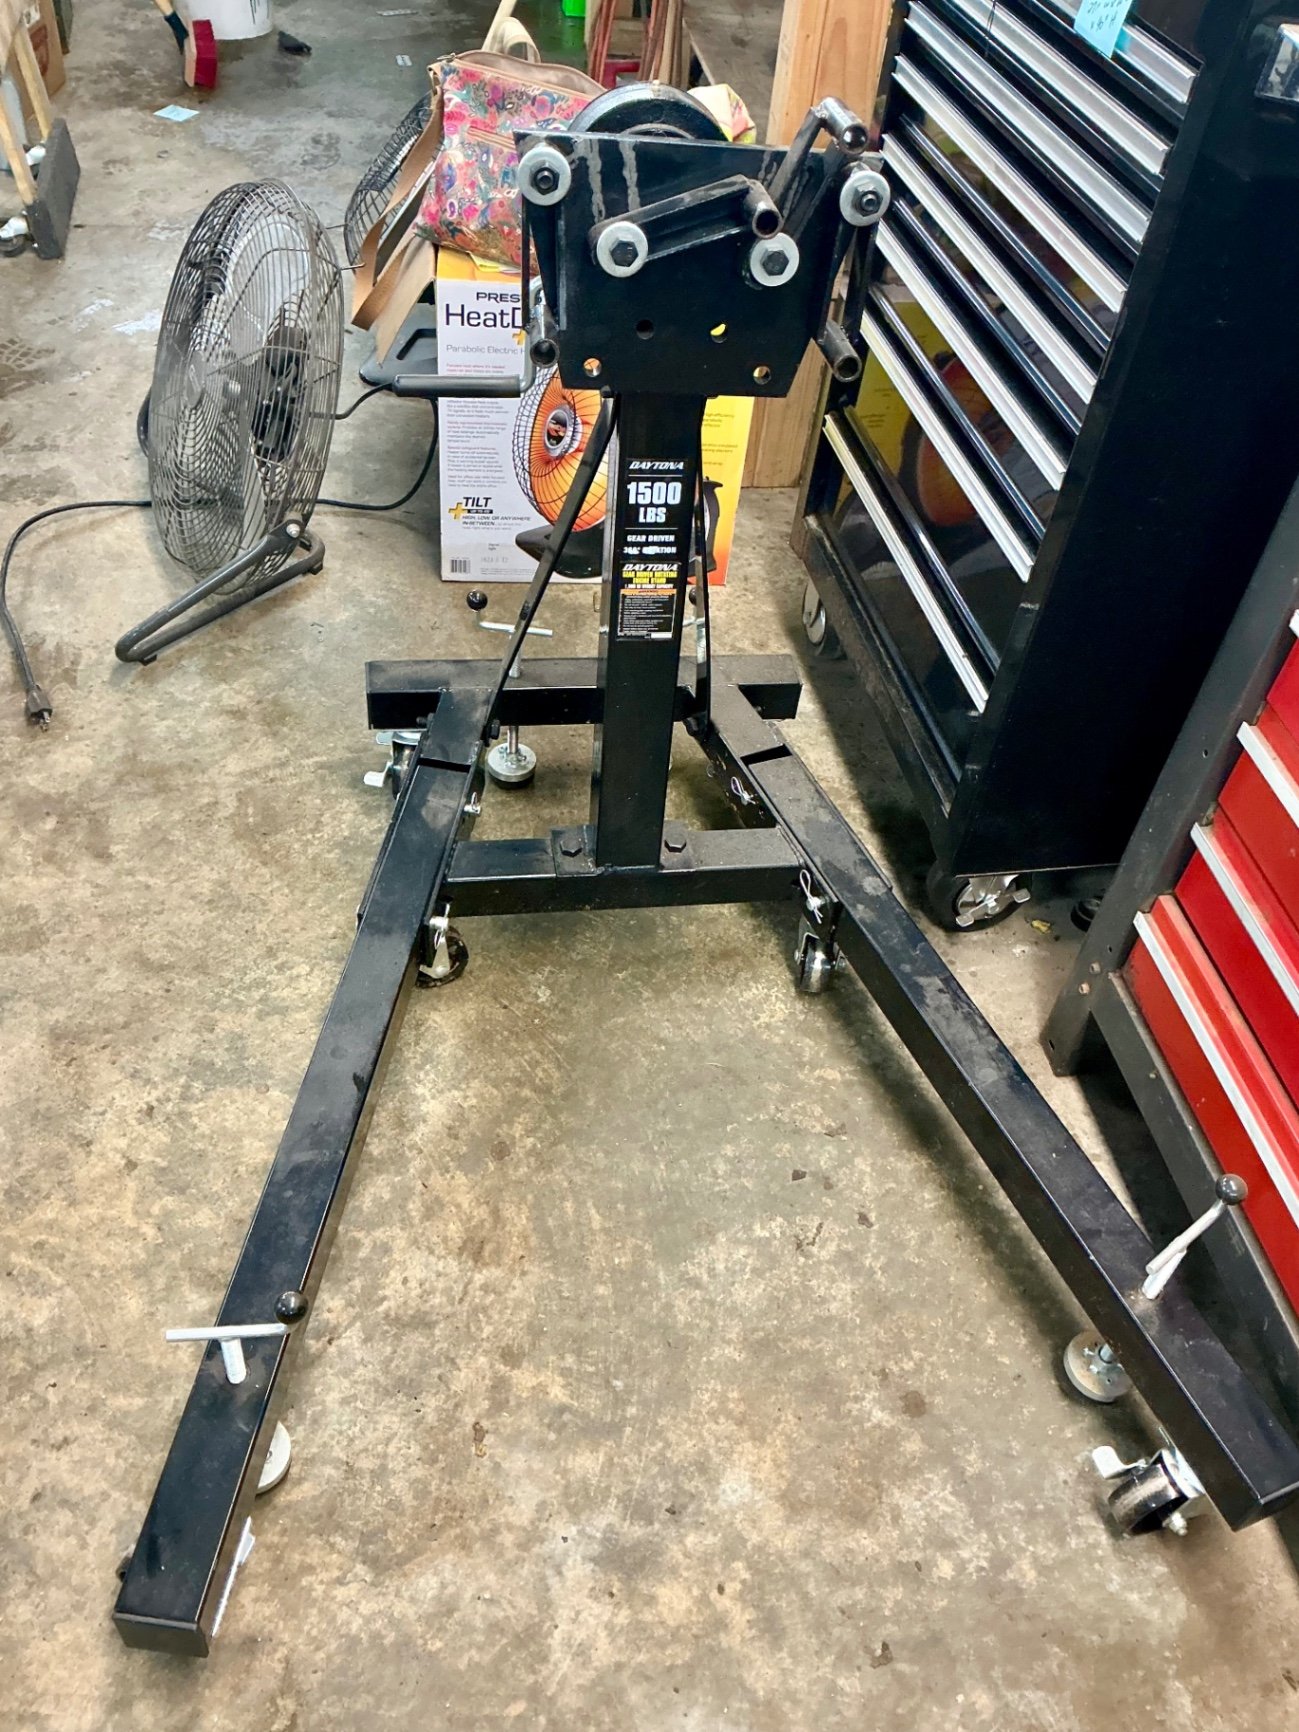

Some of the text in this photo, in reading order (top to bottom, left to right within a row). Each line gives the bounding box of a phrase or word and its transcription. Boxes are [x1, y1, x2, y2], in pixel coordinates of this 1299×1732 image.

[446, 344, 486, 354] Parabolic
[487, 345, 518, 355] Electric
[629, 461, 684, 470] DAYTONA
[626, 481, 682, 505] 1500
[463, 496, 492, 508] TILT
[638, 506, 667, 523] LBS
[626, 534, 675, 542] GEAR DRIVEN
[623, 563, 678, 571] DAYTONA
